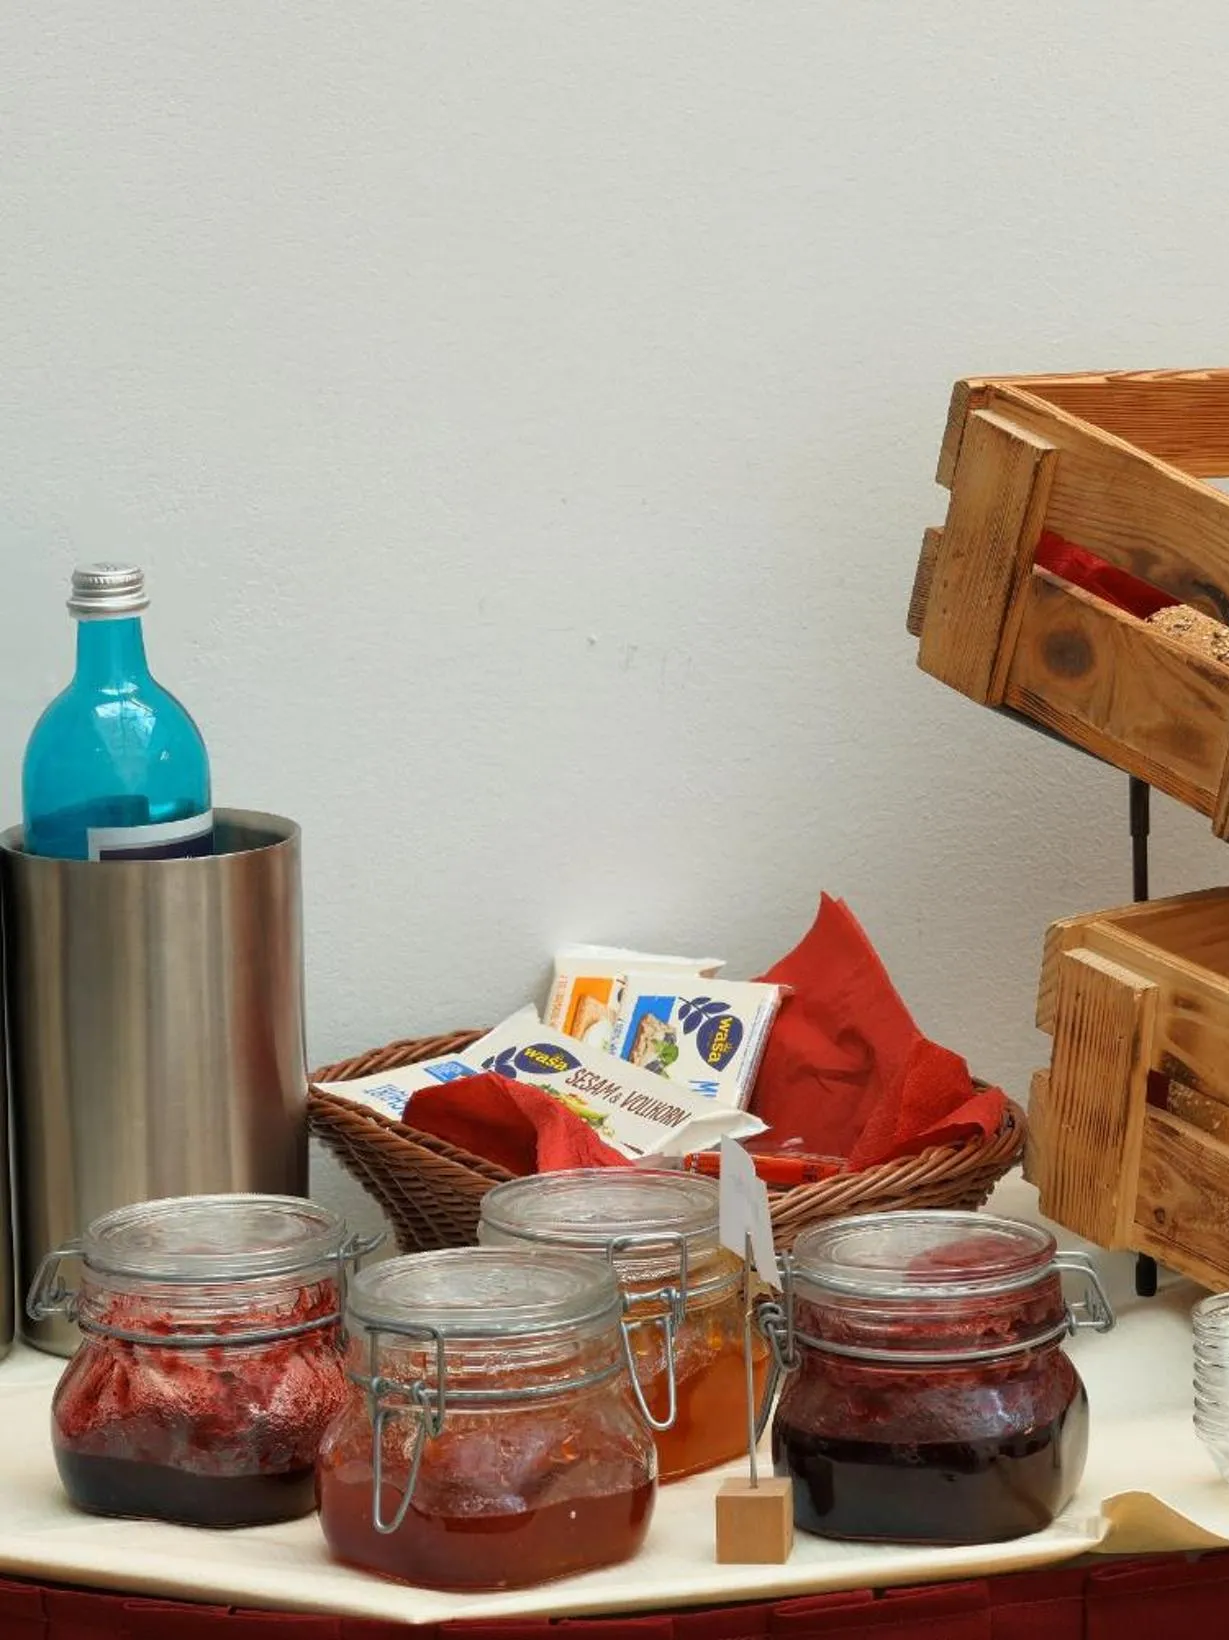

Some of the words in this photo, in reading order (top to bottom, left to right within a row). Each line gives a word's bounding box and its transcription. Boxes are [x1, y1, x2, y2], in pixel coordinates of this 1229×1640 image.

[565, 1068, 622, 1100] SESAM
[609, 1093, 622, 1103] &
[620, 1091, 692, 1128] VOLLKORN
